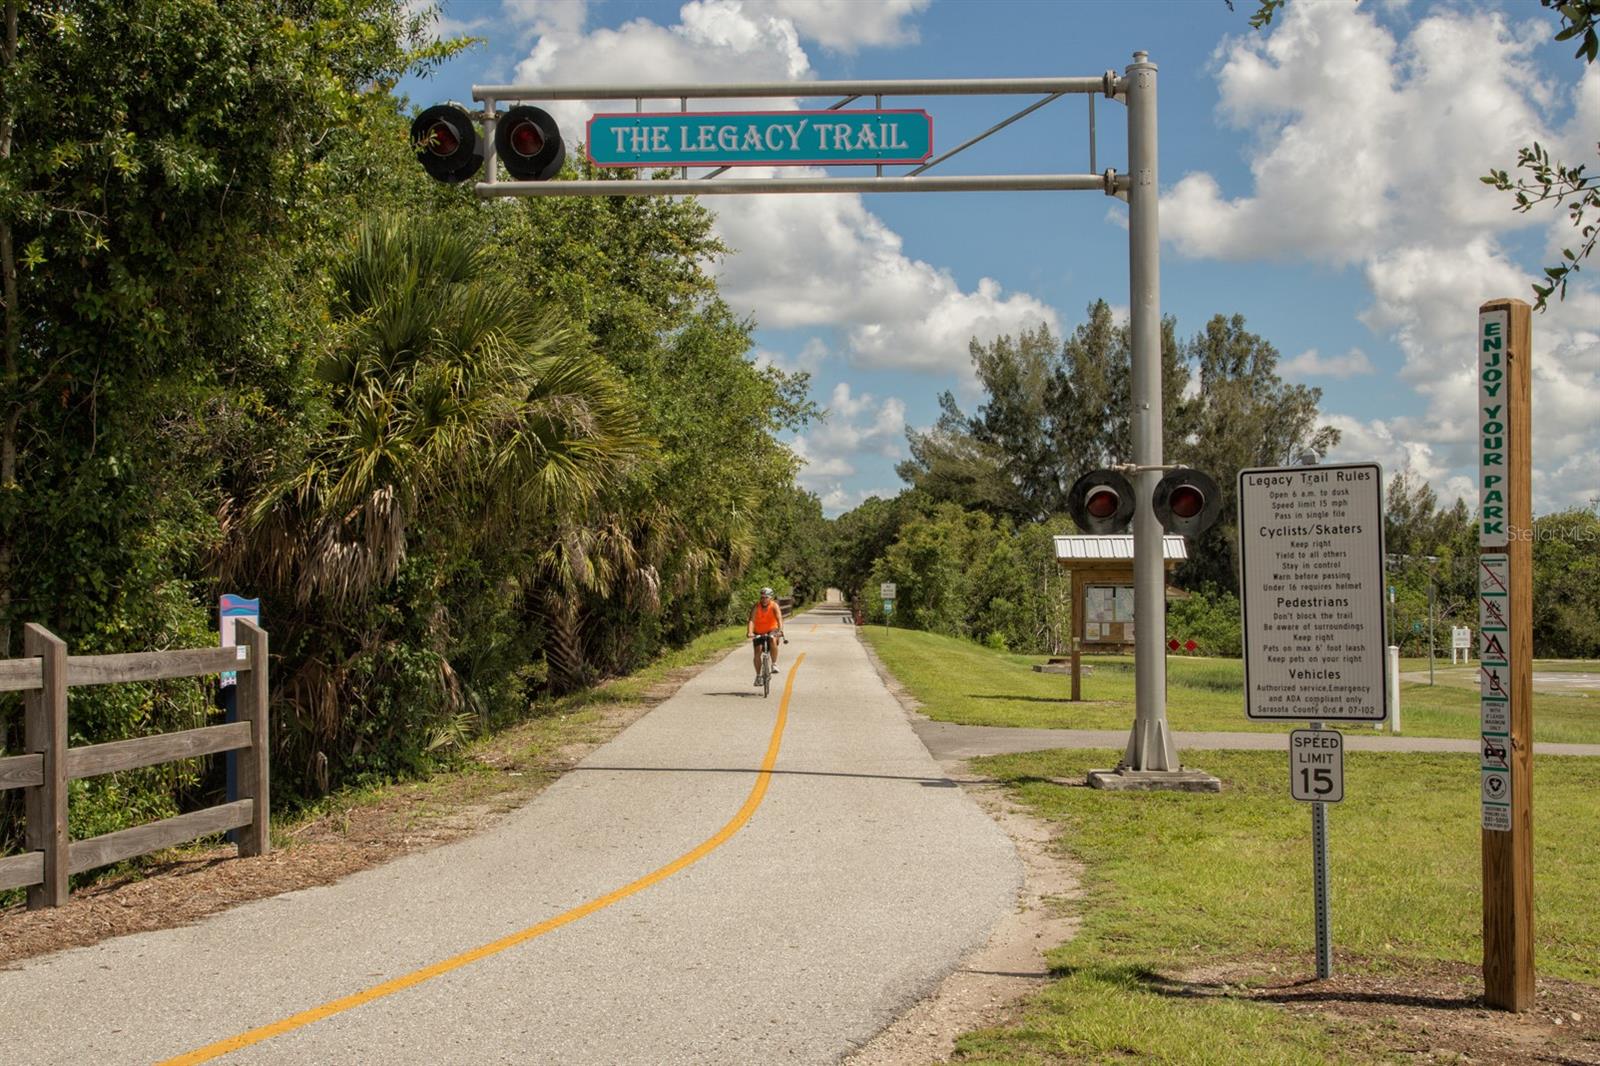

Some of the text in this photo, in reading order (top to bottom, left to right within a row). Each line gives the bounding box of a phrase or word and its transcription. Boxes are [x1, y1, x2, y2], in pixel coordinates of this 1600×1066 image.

[610, 119, 909, 152] THE LEGACY TRAIL
[1482, 323, 1502, 397] ENJOY
[1482, 405, 1503, 465] YOUR
[1249, 471, 1371, 488] Legacy Trail Rules
[1272, 502, 1294, 510] Speed
[1332, 500, 1348, 508] mph
[1483, 475, 1503, 535] PARK
[1307, 511, 1328, 519] single
[1260, 524, 1362, 538] Cyclists/Skaters
[1291, 540, 1331, 549] Keep right
[1323, 572, 1351, 581] passing
[1263, 580, 1362, 591] Under 16 requires helmet
[1277, 597, 1349, 607] Pedestrians
[1274, 612, 1293, 620] Don't
[1314, 623, 1364, 631] surroundings
[1343, 655, 1362, 664] right
[1289, 669, 1341, 680] Vehicles
[1305, 696, 1342, 704] compliant
[1293, 706, 1318, 714] County
[1295, 737, 1339, 748] SPEED
[1299, 753, 1333, 764] LIMIT
[1301, 768, 1333, 794] 15
